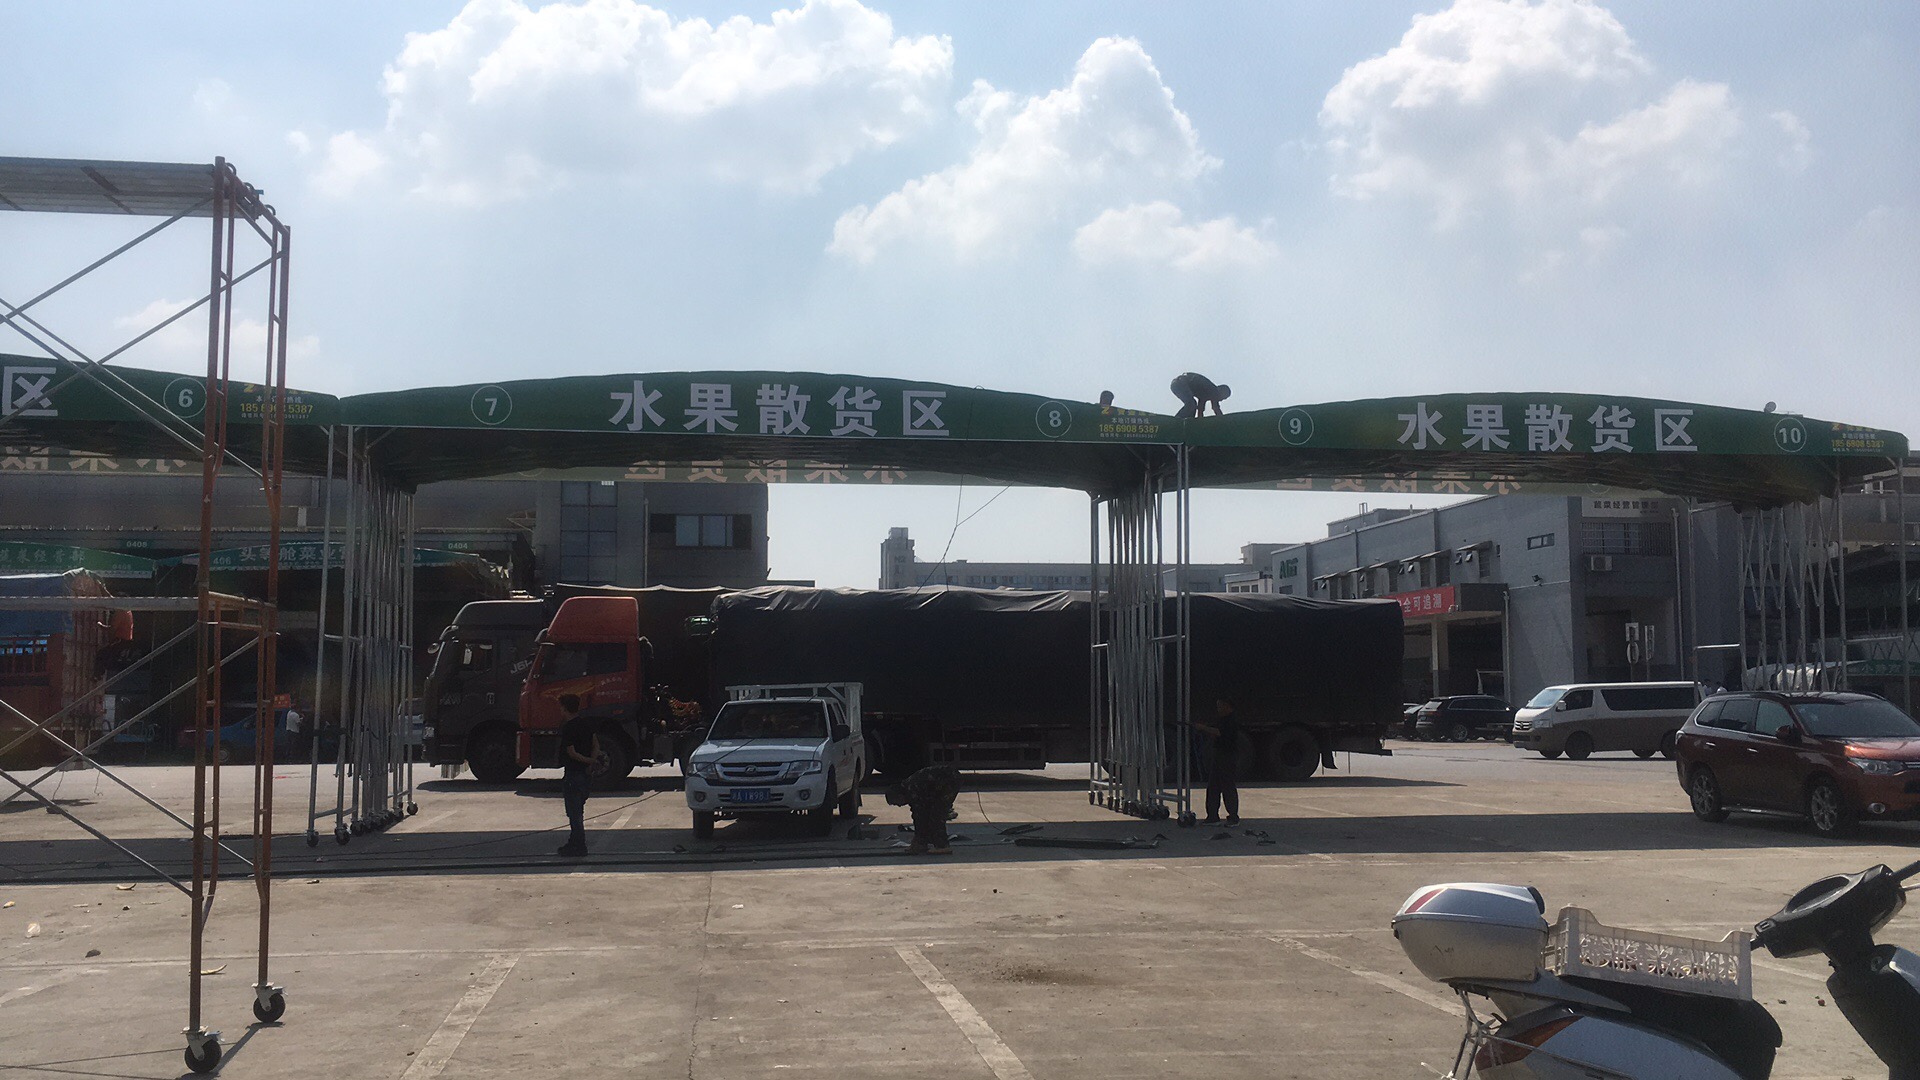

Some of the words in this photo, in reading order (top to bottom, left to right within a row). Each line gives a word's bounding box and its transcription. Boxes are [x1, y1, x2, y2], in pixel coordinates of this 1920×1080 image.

[1, 366, 58, 416] 区
[178, 388, 193, 408] 6
[288, 404, 313, 414] 5387
[484, 398, 498, 417] 7
[608, 379, 950, 438] 水果散货区
[1048, 409, 1063, 428] 8
[1289, 417, 1303, 435] 9
[1397, 401, 1699, 454] 水果散货区
[1099, 424, 1114, 433] 185
[1116, 425, 1137, 434] 6908
[1139, 426, 1159, 435] 5387
[1778, 427, 1802, 445] 10
